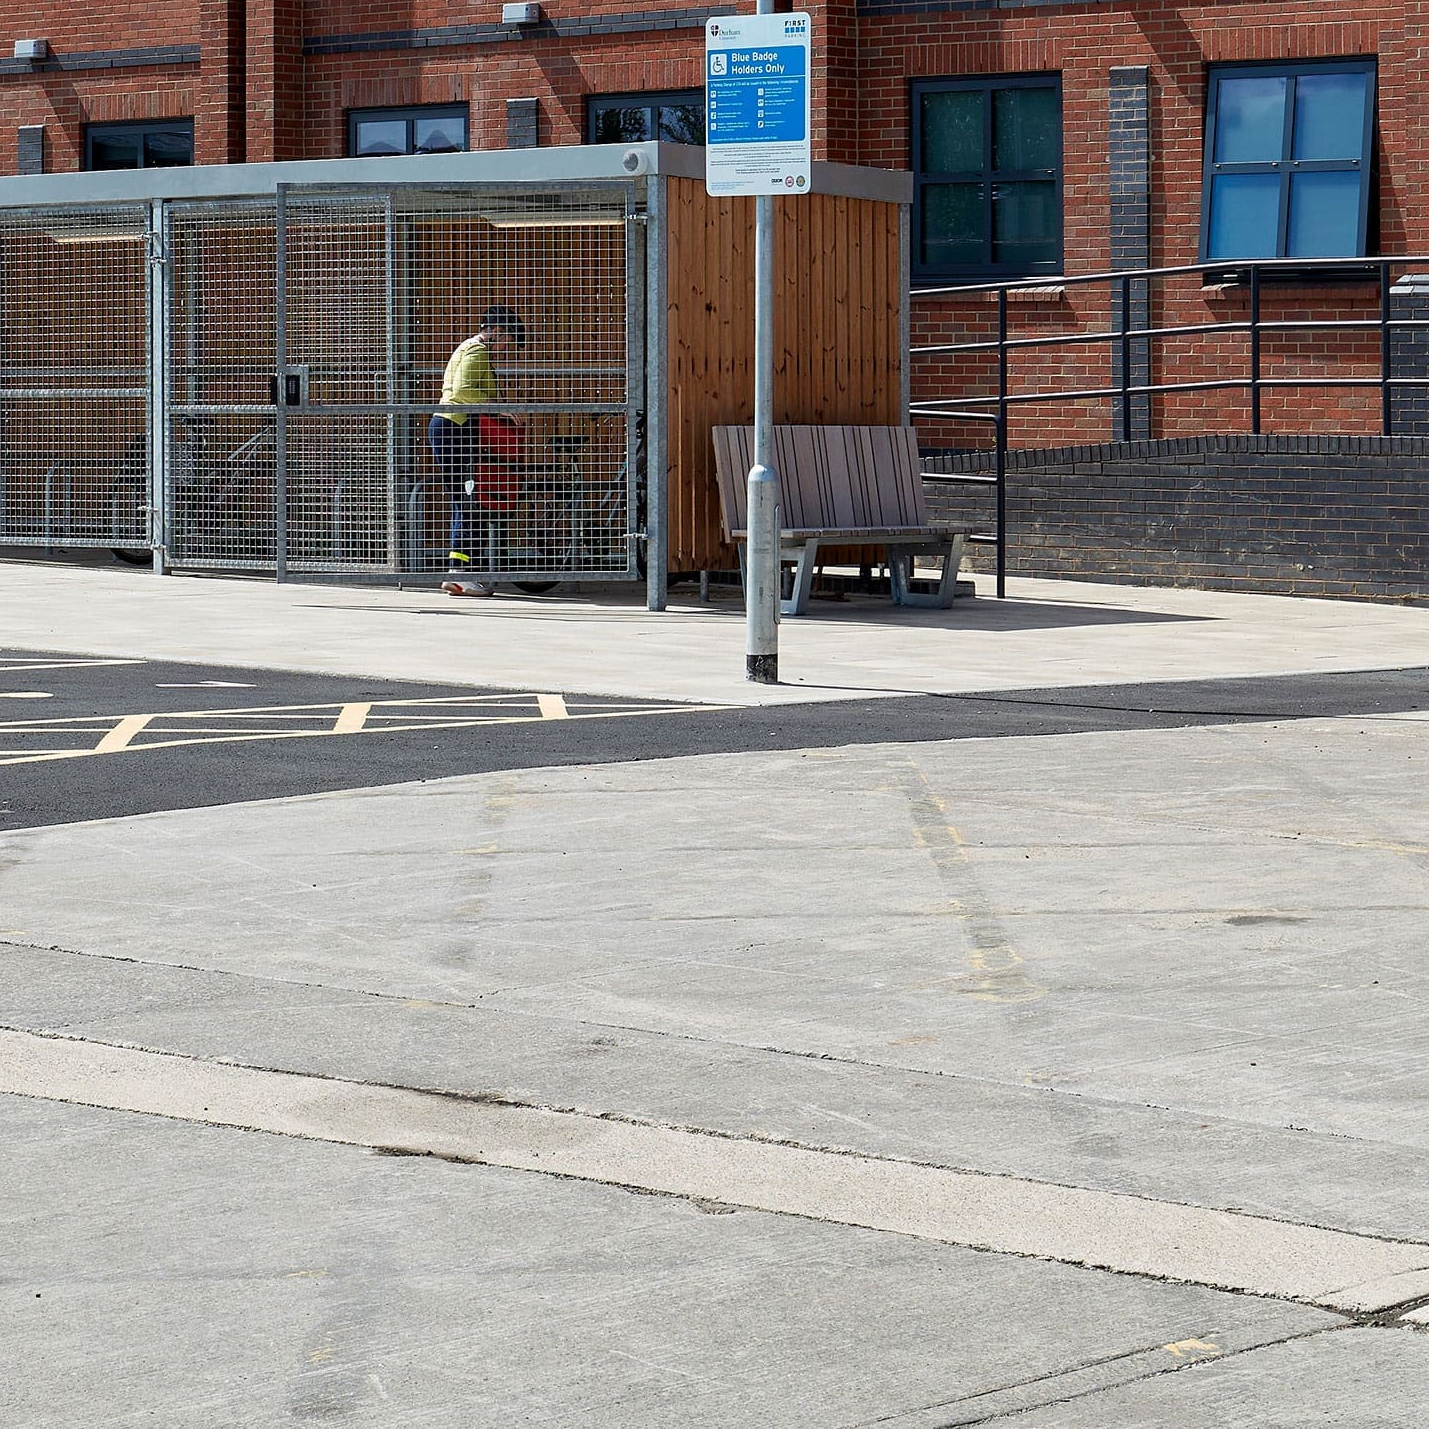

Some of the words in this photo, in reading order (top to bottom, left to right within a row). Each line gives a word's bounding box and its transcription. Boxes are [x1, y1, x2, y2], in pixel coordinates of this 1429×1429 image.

[785, 19, 806, 27] FIRST
[731, 53, 750, 62] Blue
[752, 51, 778, 62] Badge
[731, 65, 763, 75] Holders
[765, 63, 785, 74] Only
